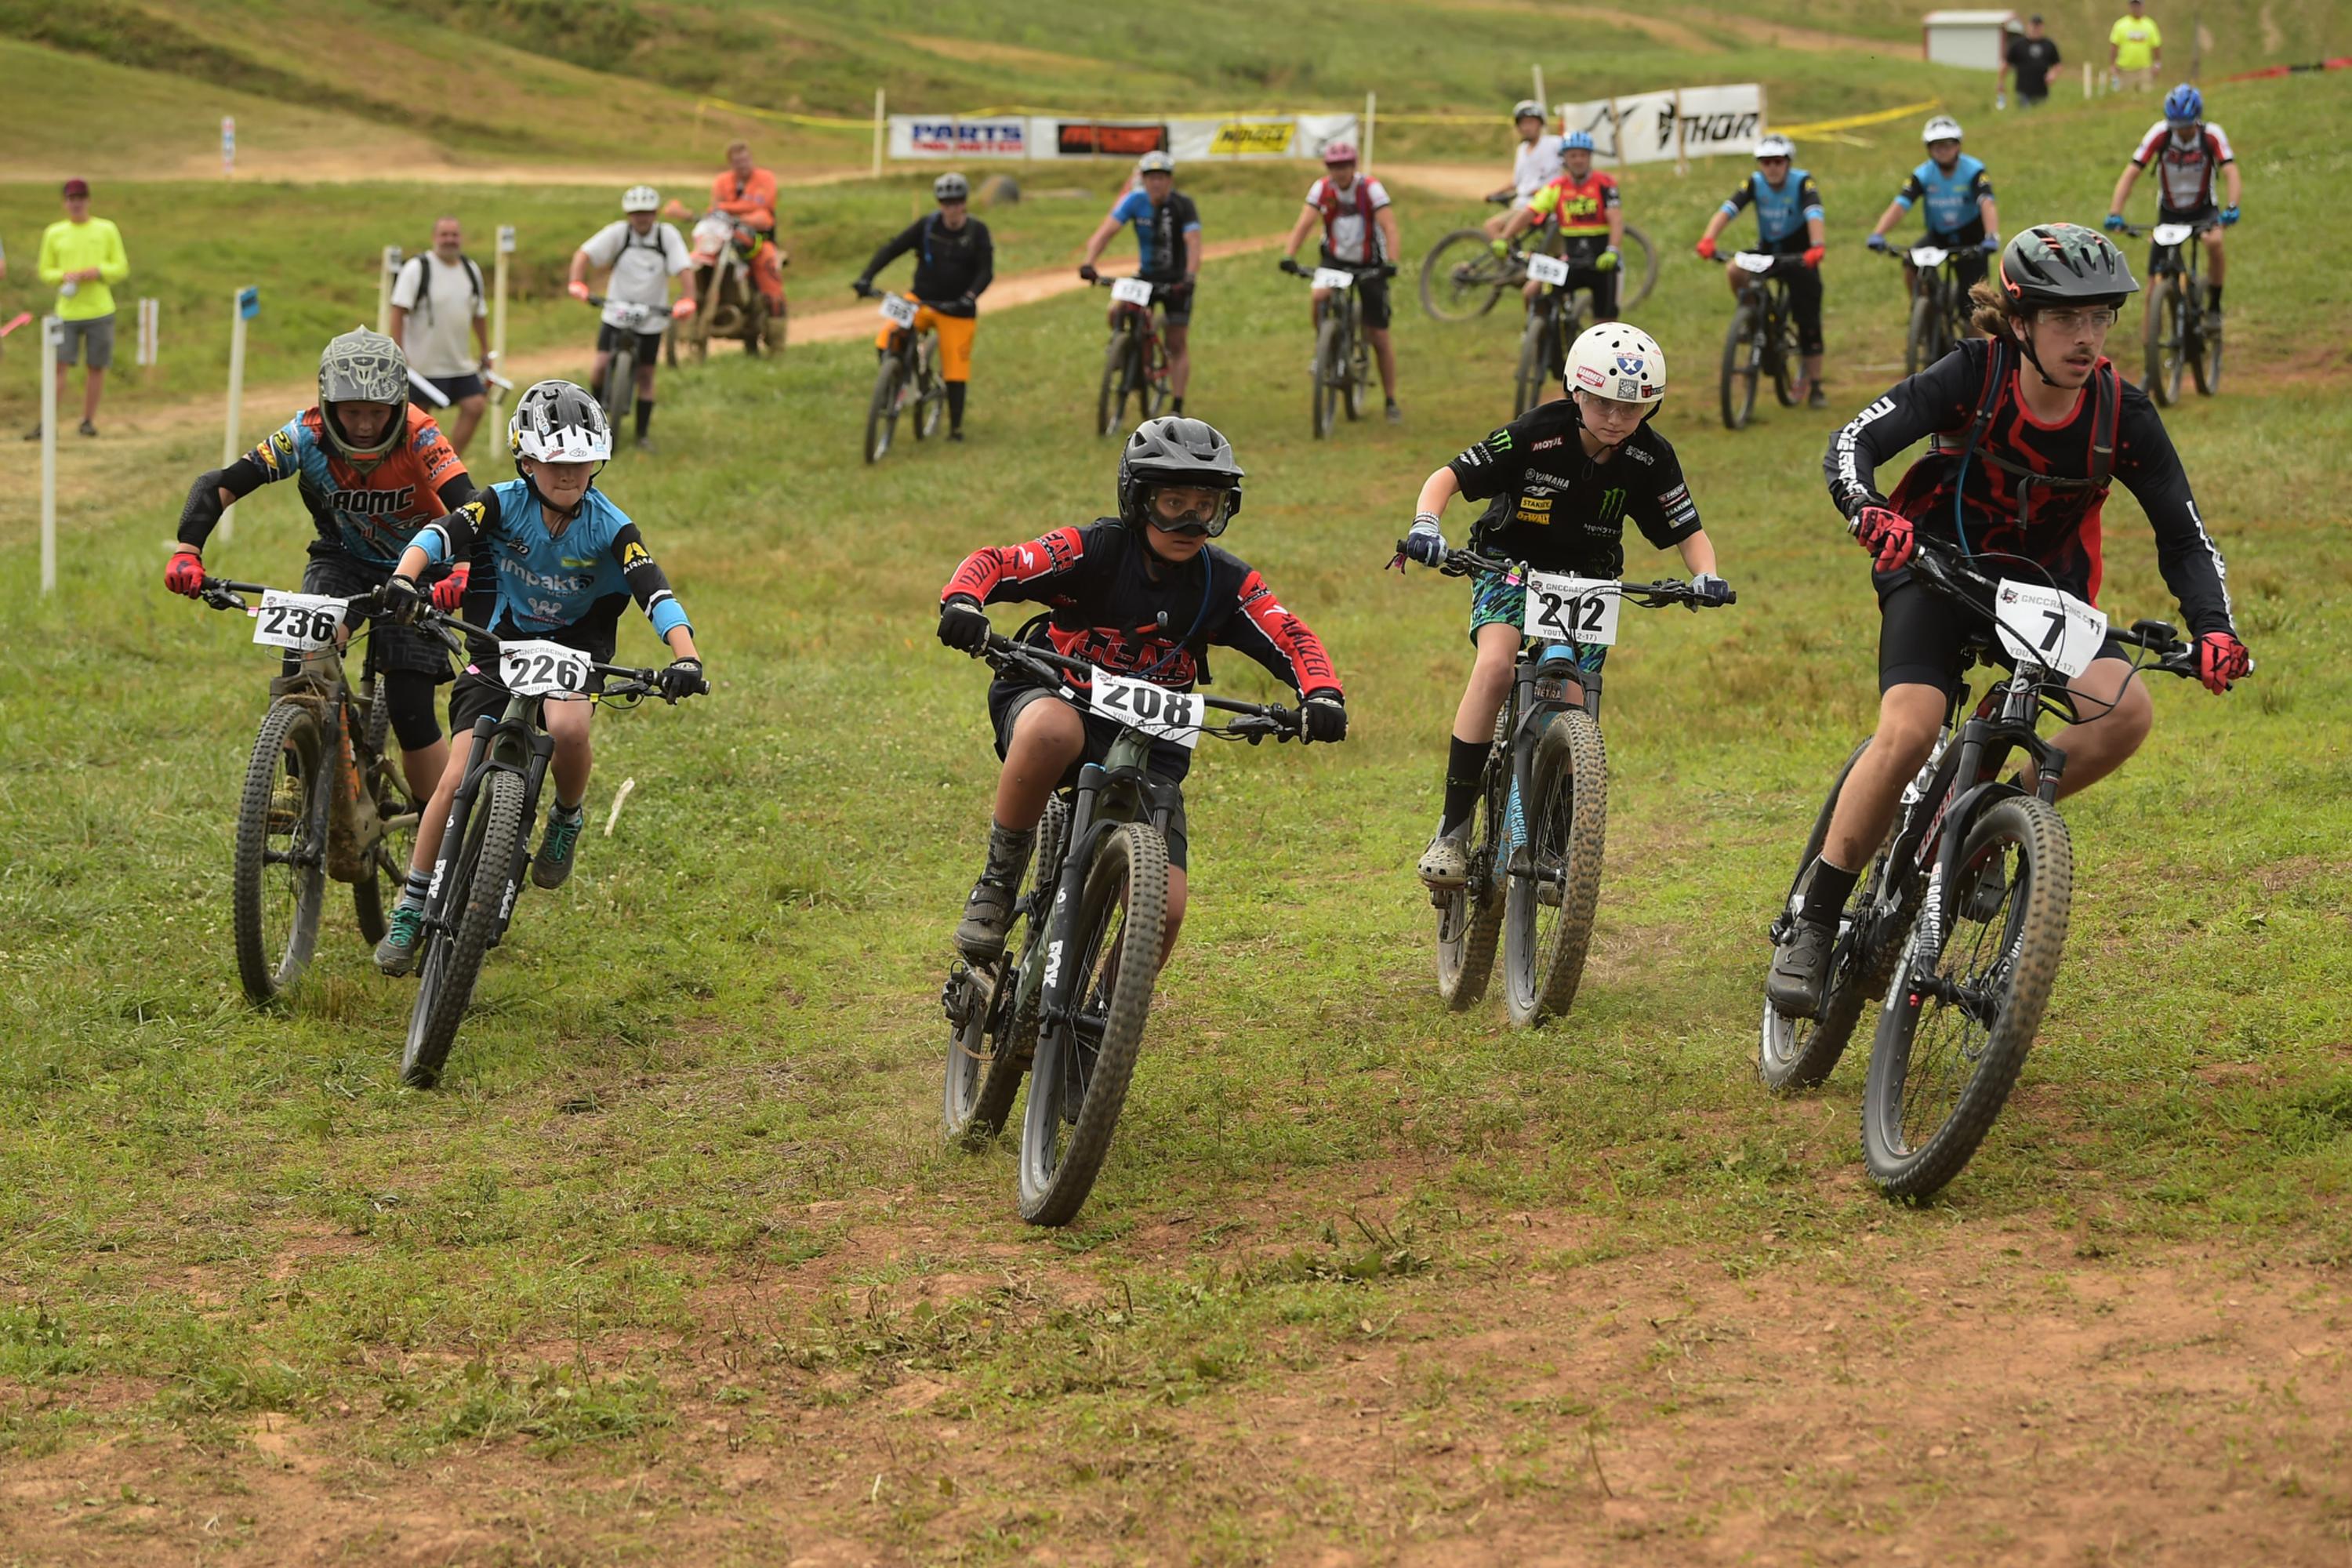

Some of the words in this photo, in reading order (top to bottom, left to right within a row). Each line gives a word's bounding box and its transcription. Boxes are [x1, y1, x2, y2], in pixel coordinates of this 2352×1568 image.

[913, 124, 1022, 140] PARTS
[1680, 112, 1759, 143] THOR
[1535, 472, 1570, 488] YAMAHA
[623, 556, 654, 575] ARMA
[263, 607, 336, 642] 236
[1538, 593, 1606, 632] 212
[2039, 610, 2066, 652] 7
[2009, 647, 2036, 659] YOUT
[510, 655, 579, 690] 226
[1102, 683, 1192, 728] 208
[427, 859, 448, 899] FOX
[1042, 940, 1064, 989] FOX
